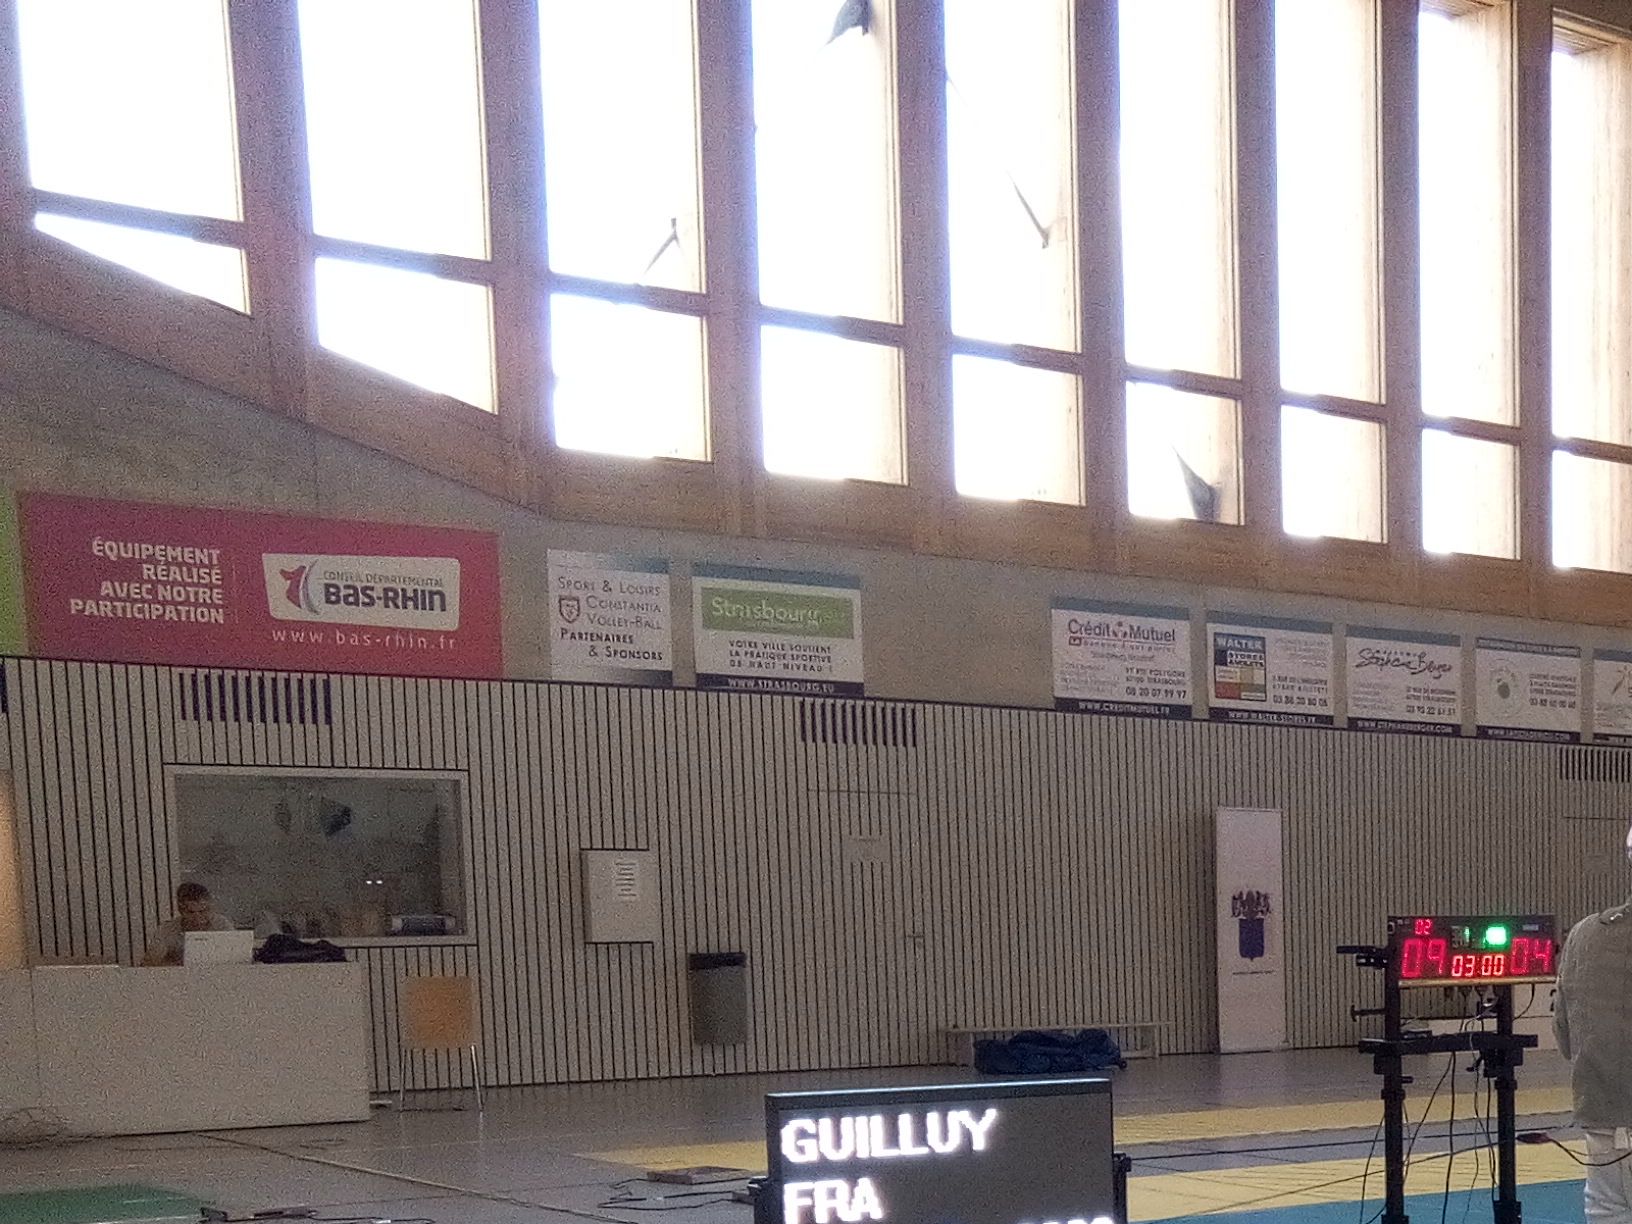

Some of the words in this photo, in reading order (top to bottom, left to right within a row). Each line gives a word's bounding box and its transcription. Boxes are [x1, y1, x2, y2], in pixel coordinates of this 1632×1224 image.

[92, 536, 220, 565] ÉQUIPEMENT
[142, 560, 222, 585] RÉALISÉ
[101, 580, 153, 600] AVEC
[157, 584, 223, 605] NOTRE
[602, 580, 612, 593] &
[70, 598, 225, 624] PARTICIPATION
[271, 629, 456, 650] www.bas-rhin.fr
[1068, 618, 1111, 637] Crédit
[1129, 624, 1175, 642] Mutuel
[589, 645, 598, 658] &
[1401, 938, 1447, 978] 09
[1451, 954, 1505, 977] 03:00
[1510, 938, 1551, 975] 04
[780, 1108, 998, 1163] GUILLUY
